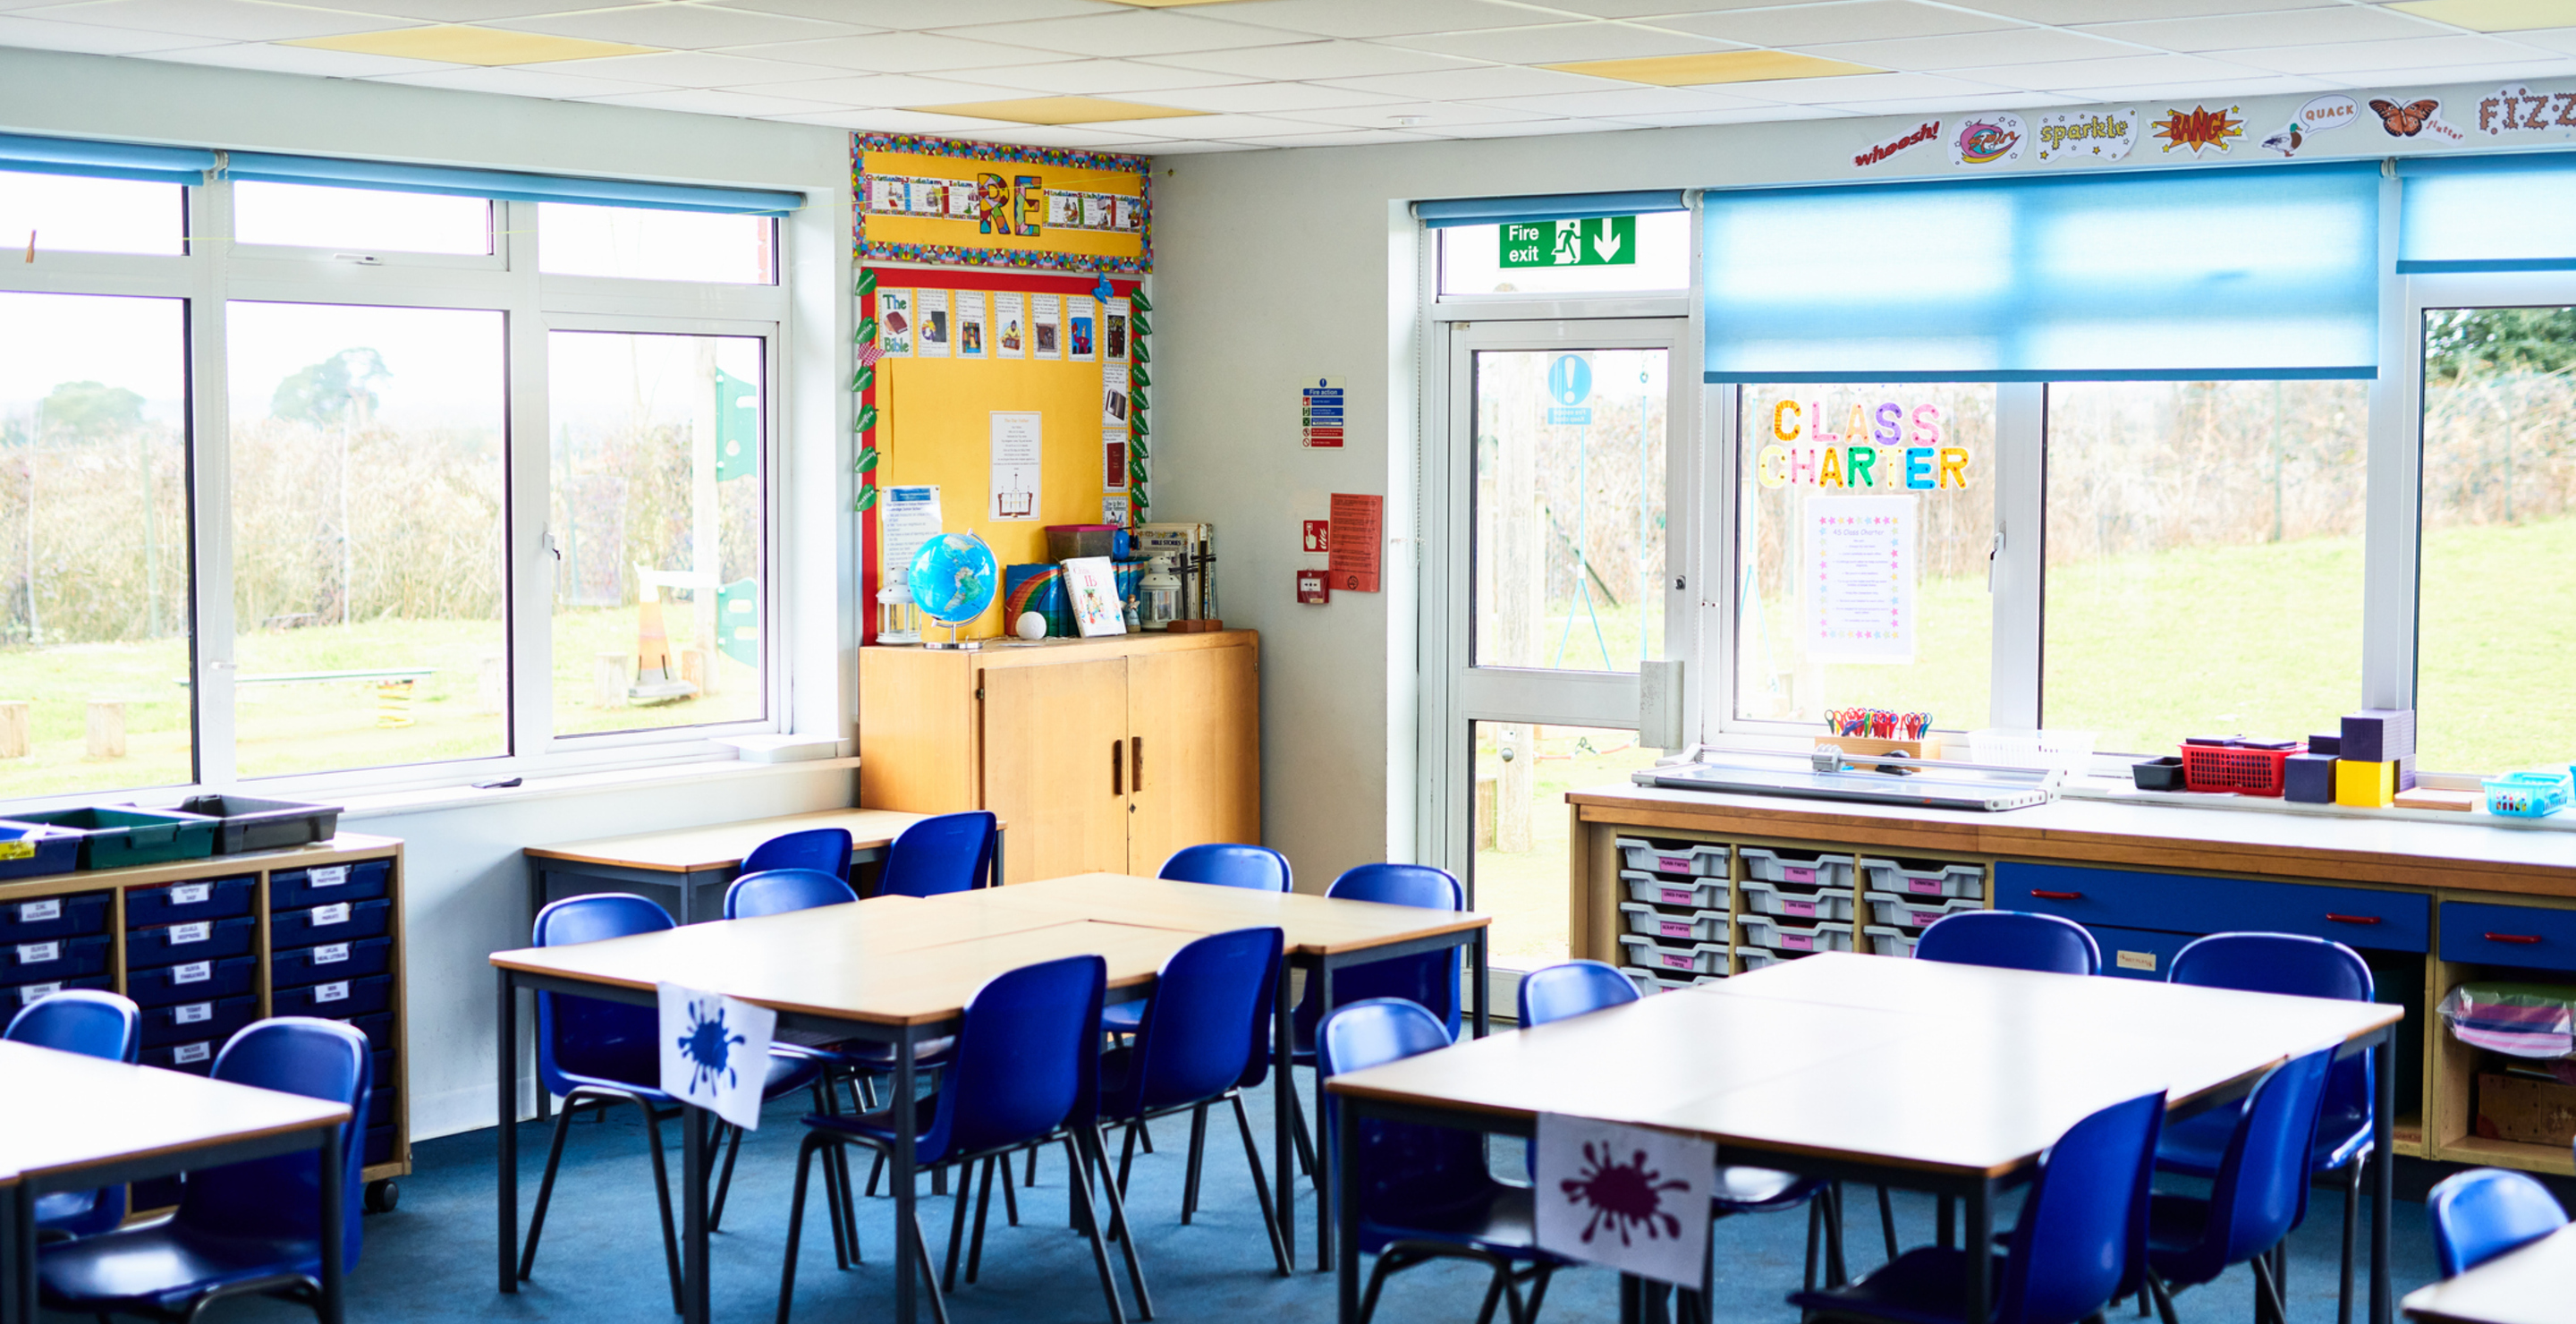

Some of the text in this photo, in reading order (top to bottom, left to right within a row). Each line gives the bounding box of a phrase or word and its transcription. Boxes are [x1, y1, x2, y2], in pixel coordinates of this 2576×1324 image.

[2304, 104, 2355, 121] QUACK
[2479, 93, 2576, 131] FIZZ
[2040, 115, 2129, 150] sparkle
[2171, 107, 2225, 141] BANG!
[2427, 120, 2464, 140] flutter
[1853, 121, 1940, 167] whoosh!
[978, 173, 1042, 236] RE
[1509, 225, 1539, 241] Fire
[1509, 246, 1539, 262] exit
[882, 294, 907, 310] The
[857, 323, 873, 341] service
[884, 337, 909, 352] Bible
[1773, 399, 1940, 446] CLASS
[1132, 463, 1144, 478] love
[1758, 446, 1970, 490] CHARTER
